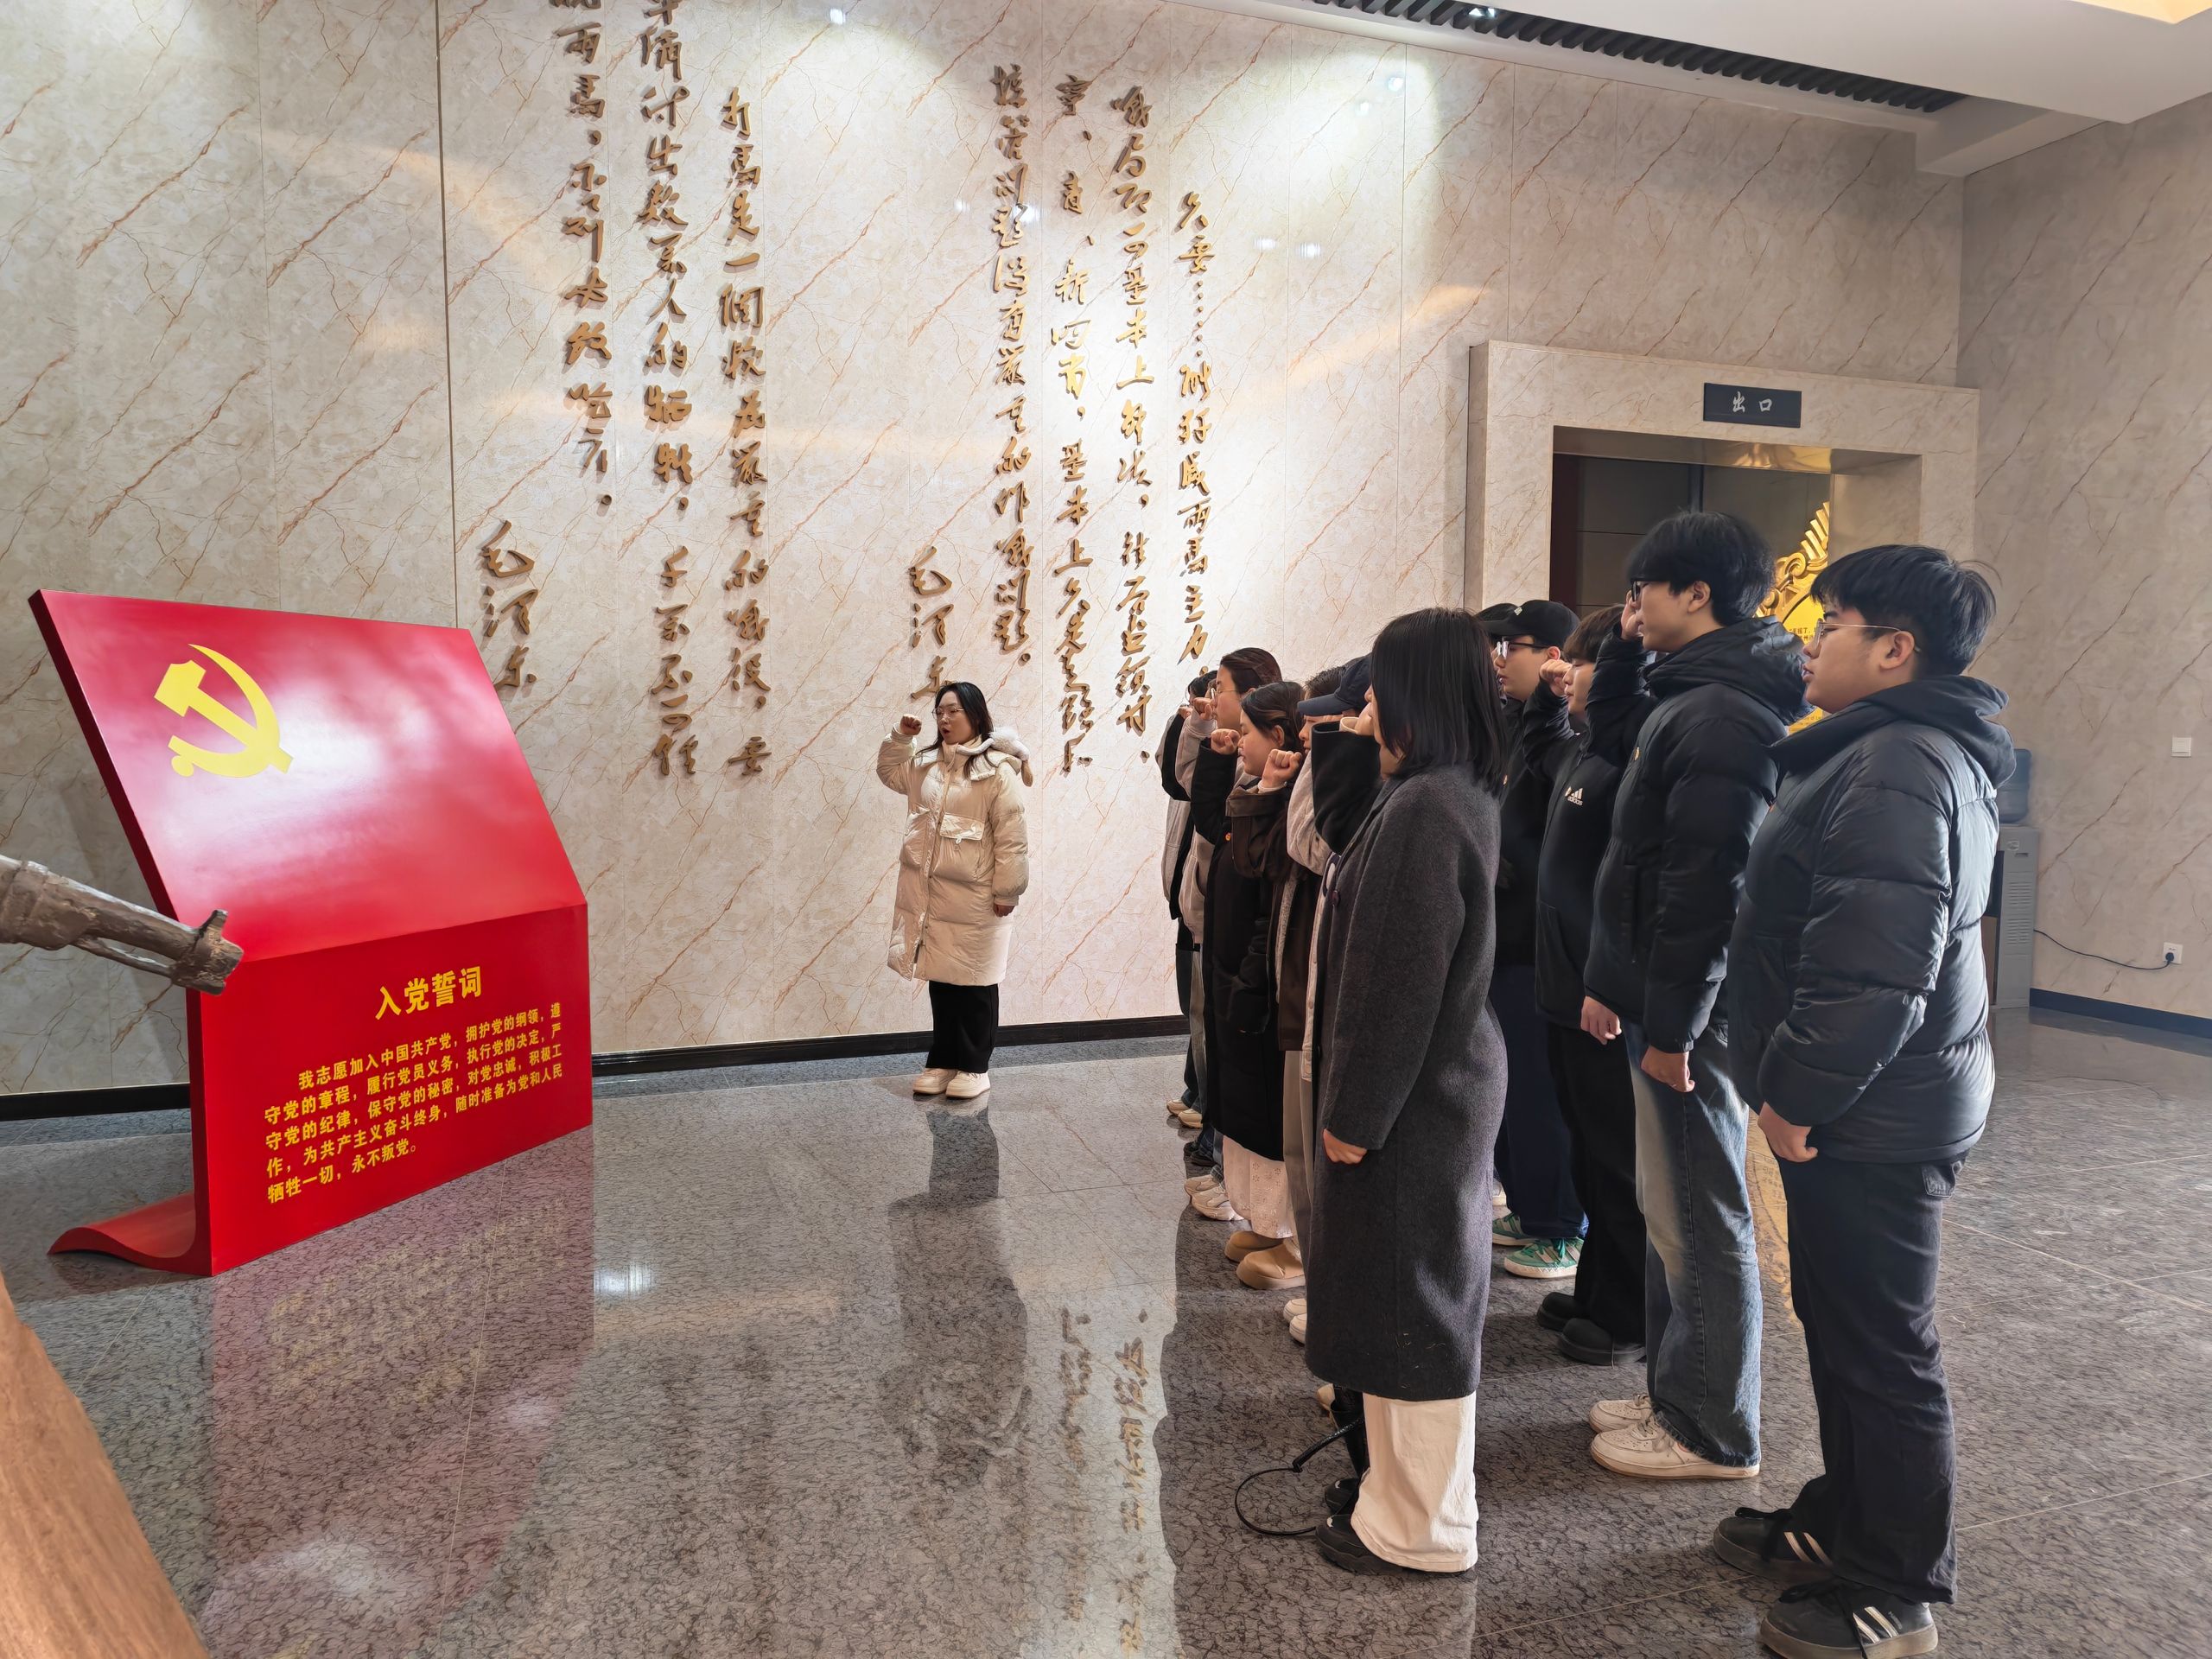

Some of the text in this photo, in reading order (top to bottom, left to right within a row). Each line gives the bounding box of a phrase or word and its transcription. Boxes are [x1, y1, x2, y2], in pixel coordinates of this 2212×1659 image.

[1732, 391, 1773, 413] 出口
[375, 965, 482, 1020] 入党誓词
[264, 1023, 562, 1125] 守党的章程，履行党员义务，执行党的决定，严
[298, 1002, 562, 1090] 我志愿加入中国共产党，拥护党的纲领，遵
[265, 1045, 563, 1151] 守党的纪律，保守党的秘密，对党忠诚，积极工
[266, 1063, 563, 1179] 作，为共产主义奋斗终身，随时准备为党和人民
[267, 1141, 416, 1204] 牺牲一切，永不叛党。
